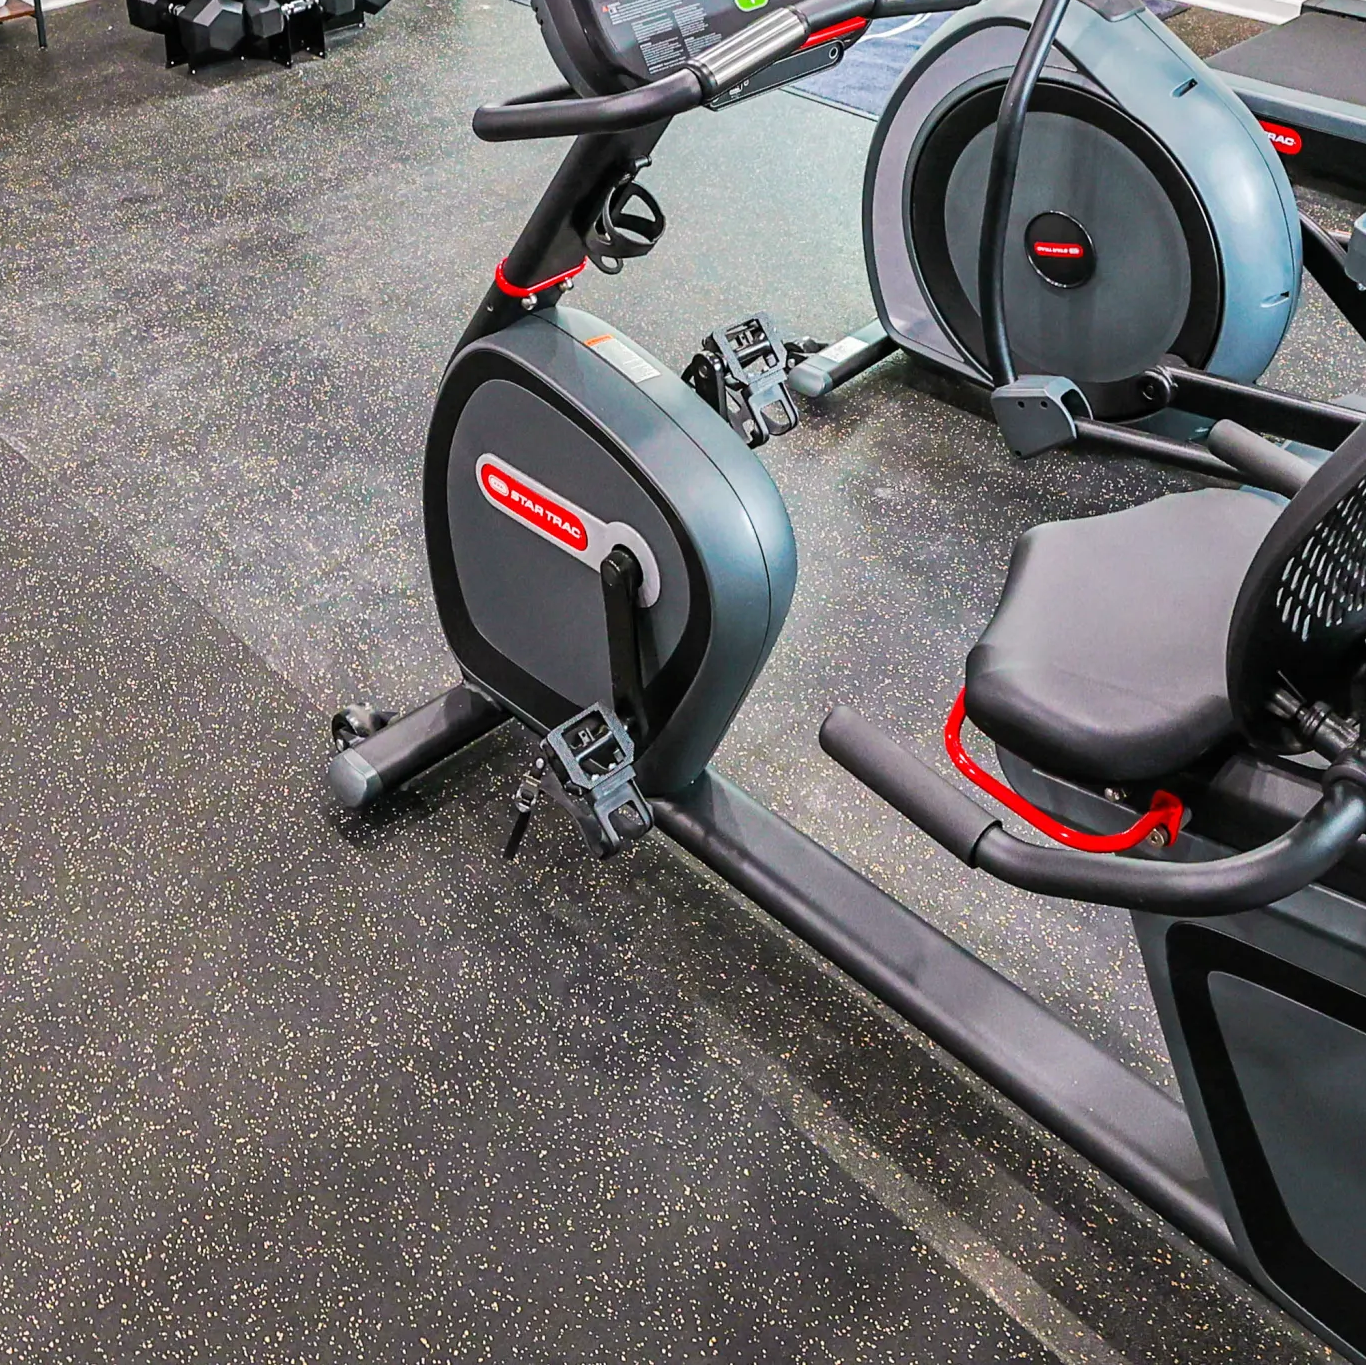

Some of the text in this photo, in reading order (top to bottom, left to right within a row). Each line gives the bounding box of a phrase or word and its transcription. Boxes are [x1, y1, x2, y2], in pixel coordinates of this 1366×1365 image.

[1266, 131, 1295, 146] RAC
[510, 490, 581, 539] STAR TRAC
